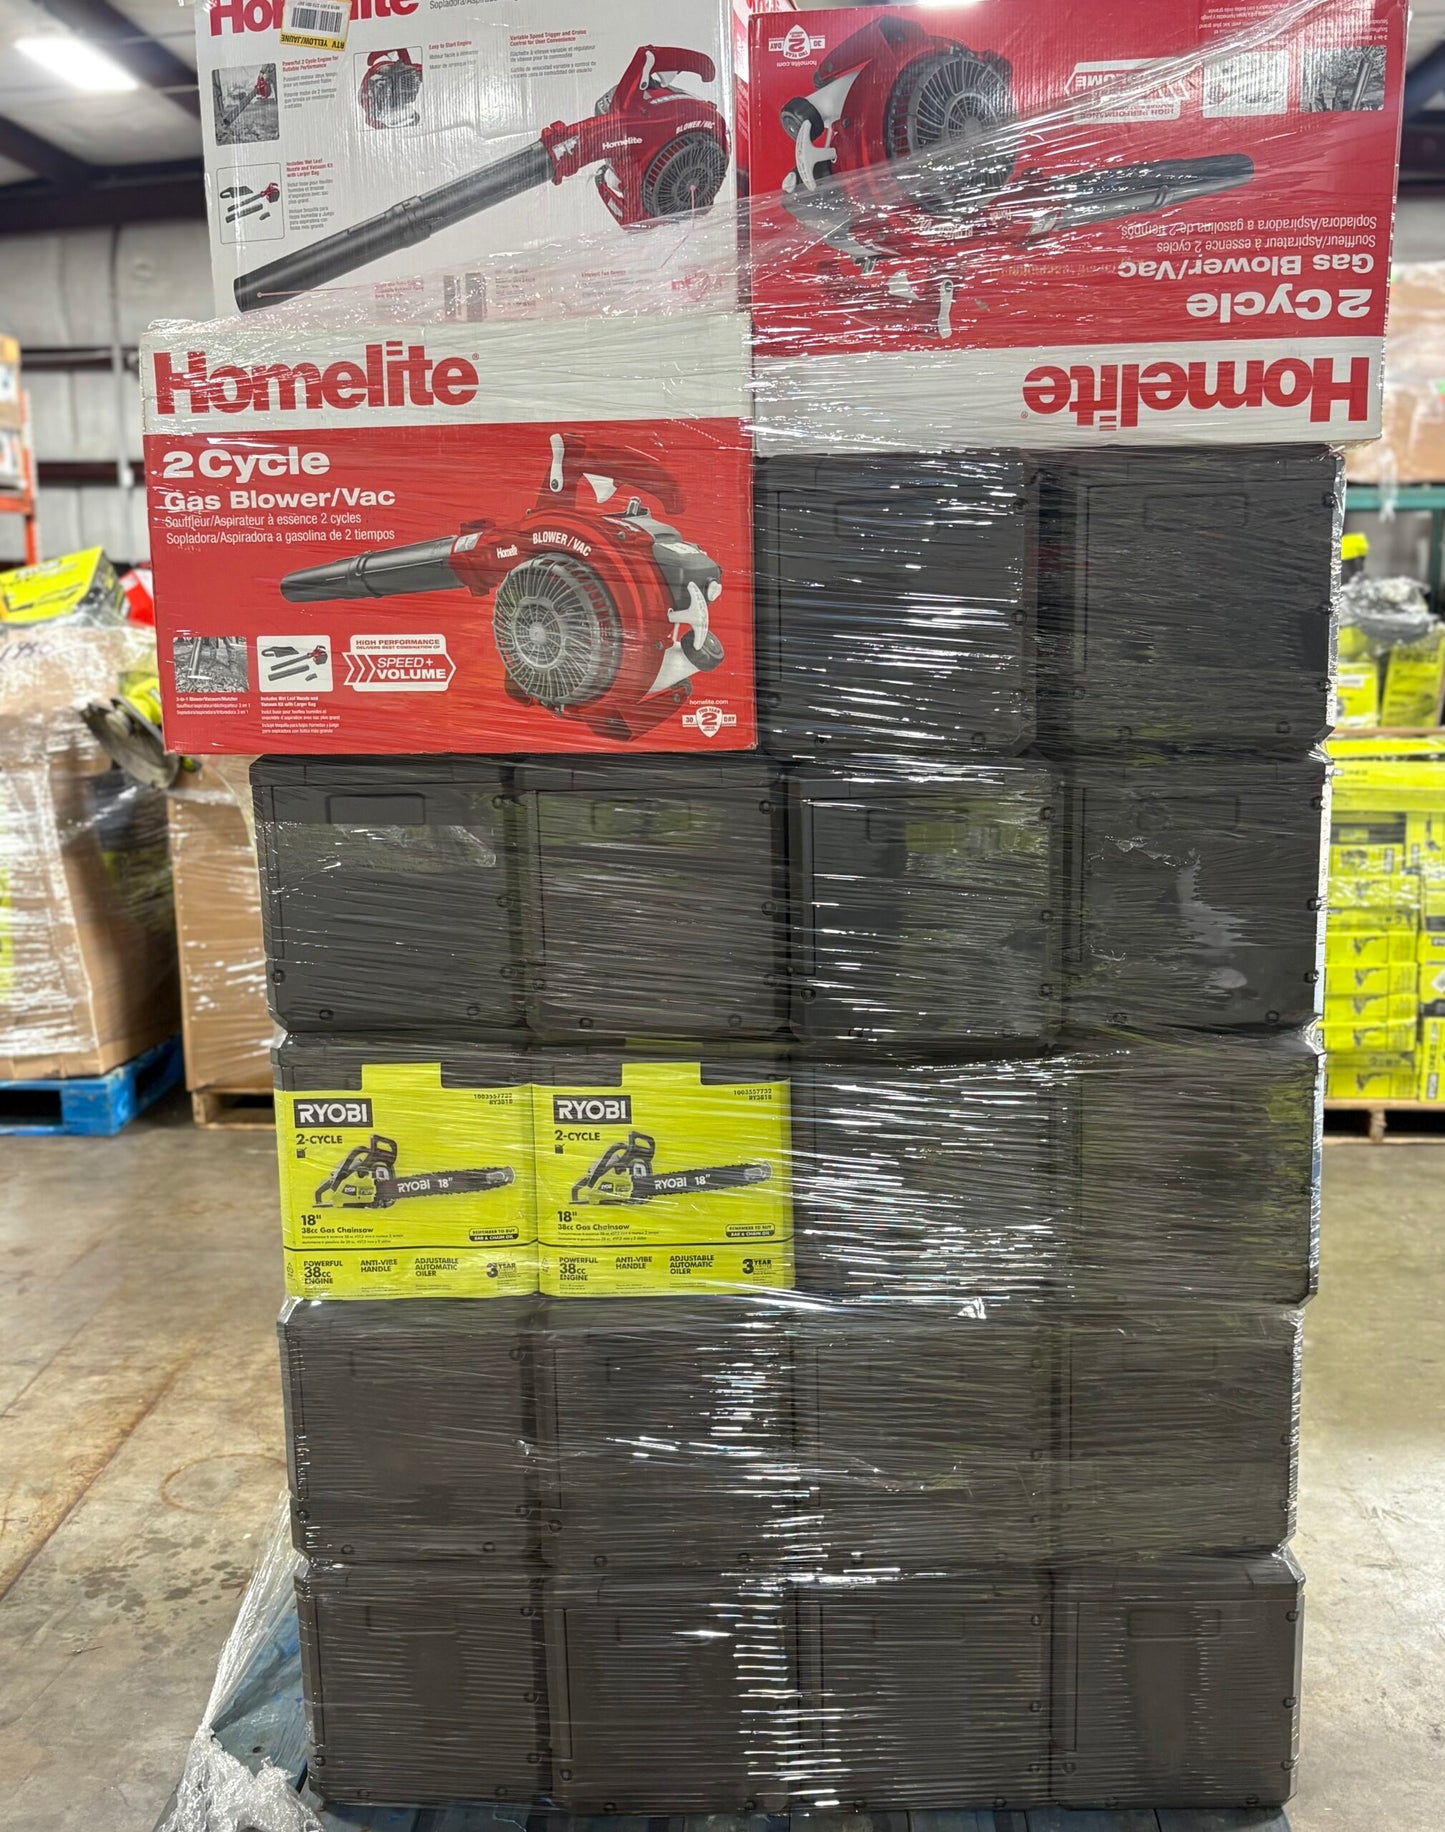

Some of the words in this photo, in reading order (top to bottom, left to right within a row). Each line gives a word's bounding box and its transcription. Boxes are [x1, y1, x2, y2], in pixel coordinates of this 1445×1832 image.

[789, 38, 805, 53] 2
[602, 136, 642, 150] Homelite
[1169, 224, 1177, 236] 2
[1179, 222, 1193, 235] de
[1197, 218, 1244, 234] gasolina
[1248, 221, 1254, 230] a
[1258, 216, 1377, 230] Sopladora/Aspiradora
[1156, 240, 1191, 253] cycles
[1195, 240, 1202, 253] 2
[1205, 238, 1251, 250] essence
[1255, 238, 1261, 252] à
[1264, 234, 1376, 249] Souffleur/Aspirateur
[1117, 252, 1301, 281] Blower/Vac
[1313, 253, 1374, 274] Gas
[1186, 283, 1332, 323] Cycle
[1337, 288, 1373, 318] 2
[163, 450, 195, 479] 2
[198, 446, 330, 484] Cycle
[164, 491, 221, 511] Gas
[230, 486, 396, 510] Blower/Vac
[165, 513, 264, 528] Souffleur/Aspirateur
[268, 512, 275, 526] à
[277, 514, 318, 526] essence
[320, 512, 328, 525] 2
[330, 512, 362, 527] cycles
[166, 531, 274, 545] Sopladora/Aspiradora
[277, 534, 283, 542] a
[285, 530, 327, 545] gasolina
[329, 529, 343, 542] de
[345, 529, 352, 541] 2
[354, 528, 395, 544] tiempos
[377, 657, 424, 668] SPEED
[376, 669, 447, 680] VOLUME
[702, 713, 718, 726] 2
[297, 1104, 369, 1123] RYOBI
[557, 1101, 628, 1120] RYOBI
[296, 1134, 343, 1145] 2-CYCLE
[554, 1130, 601, 1142] 2-CYCLE
[397, 1179, 431, 1193] RYOBI
[438, 1177, 453, 1189] 18"
[654, 1177, 687, 1190] RYOBI
[695, 1174, 711, 1185] 18"
[301, 1214, 321, 1226] 18"
[558, 1211, 578, 1222] 18"
[486, 1263, 499, 1278] 3
[742, 1259, 754, 1275] 3
